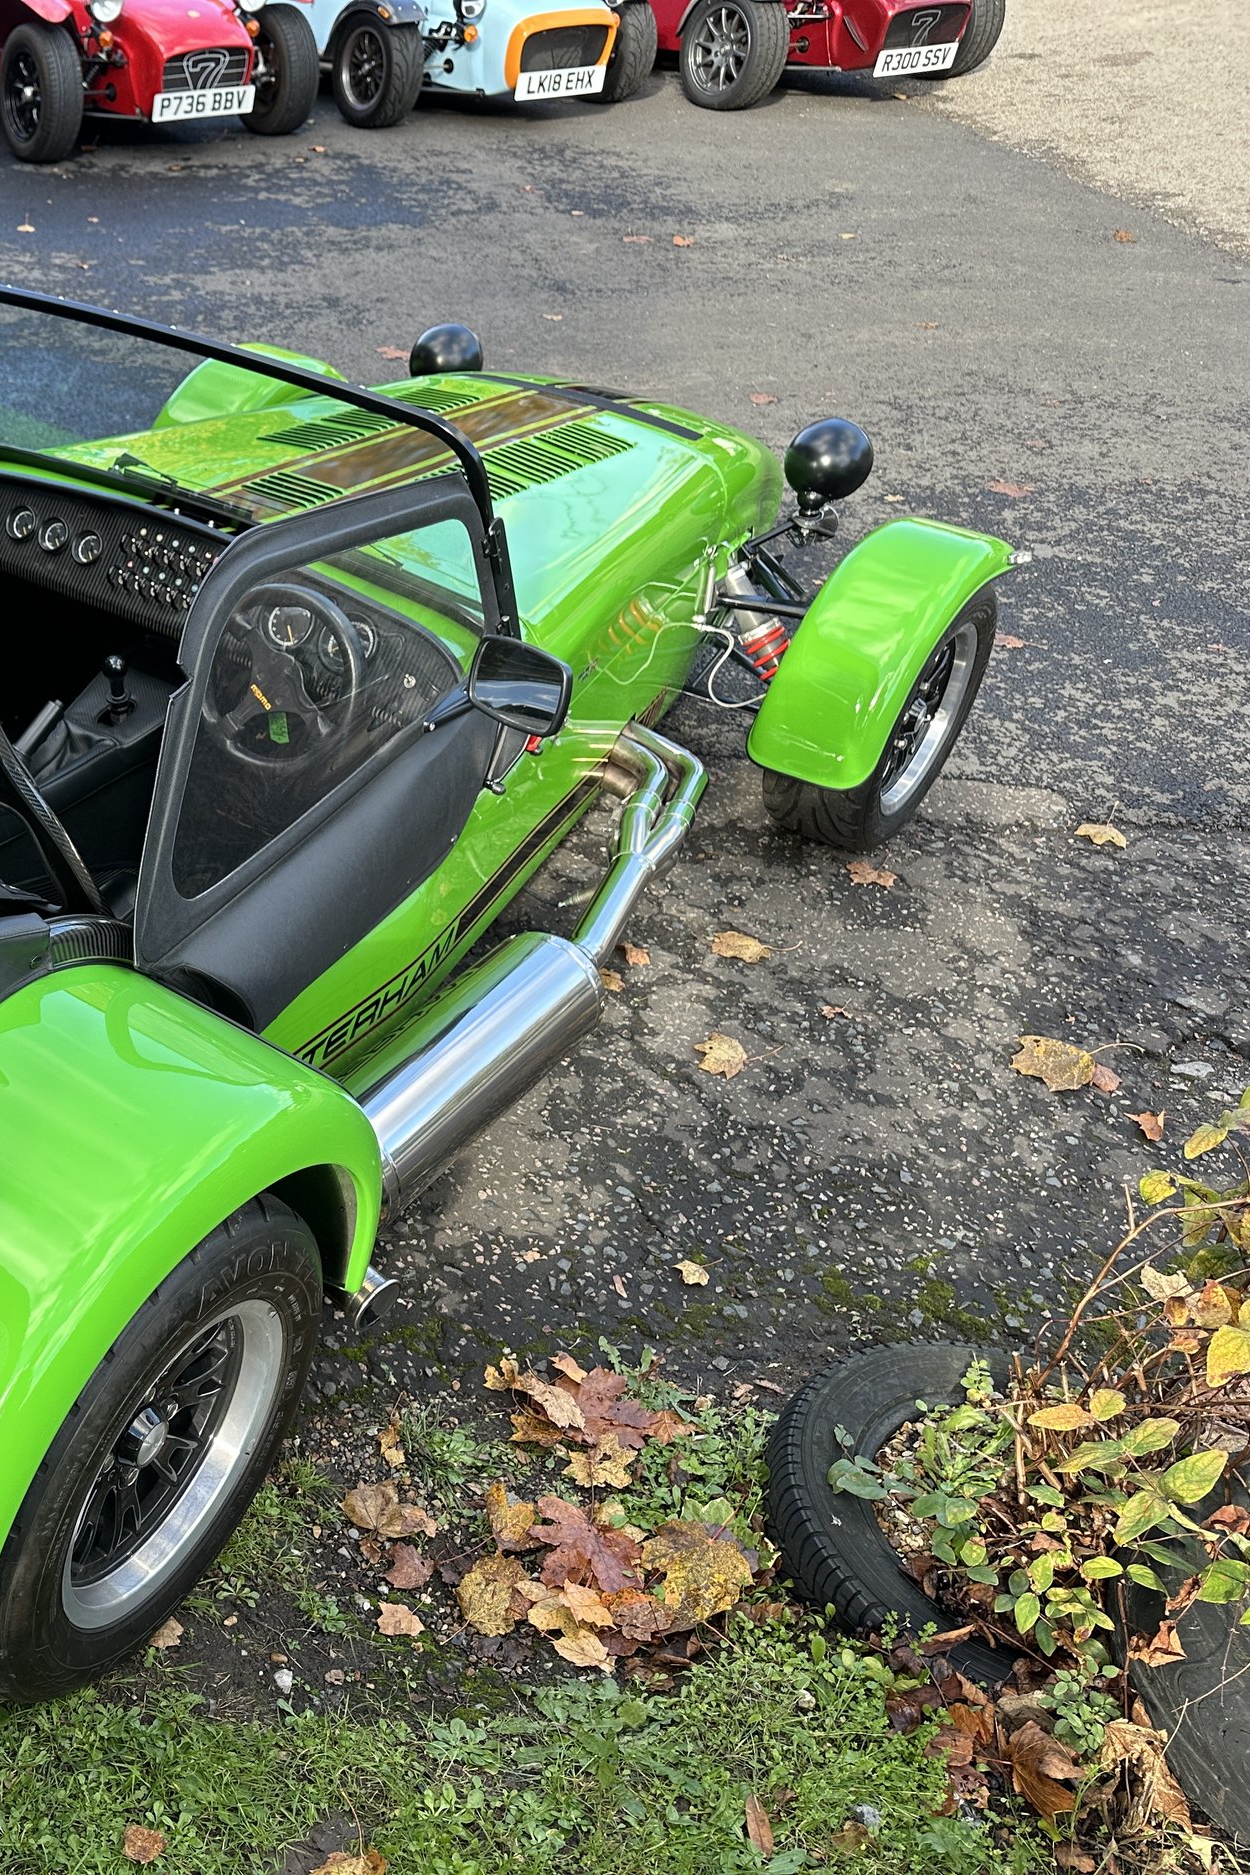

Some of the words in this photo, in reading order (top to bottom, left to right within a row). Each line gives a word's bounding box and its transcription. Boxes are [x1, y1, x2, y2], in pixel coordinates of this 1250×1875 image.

[881, 51, 921, 72] R300
[922, 47, 951, 67] SSV
[527, 73, 562, 94] LK18
[565, 70, 595, 90] EHX
[159, 94, 206, 117] P736
[211, 90, 246, 111] BBV
[197, 1241, 288, 1319] AVON
